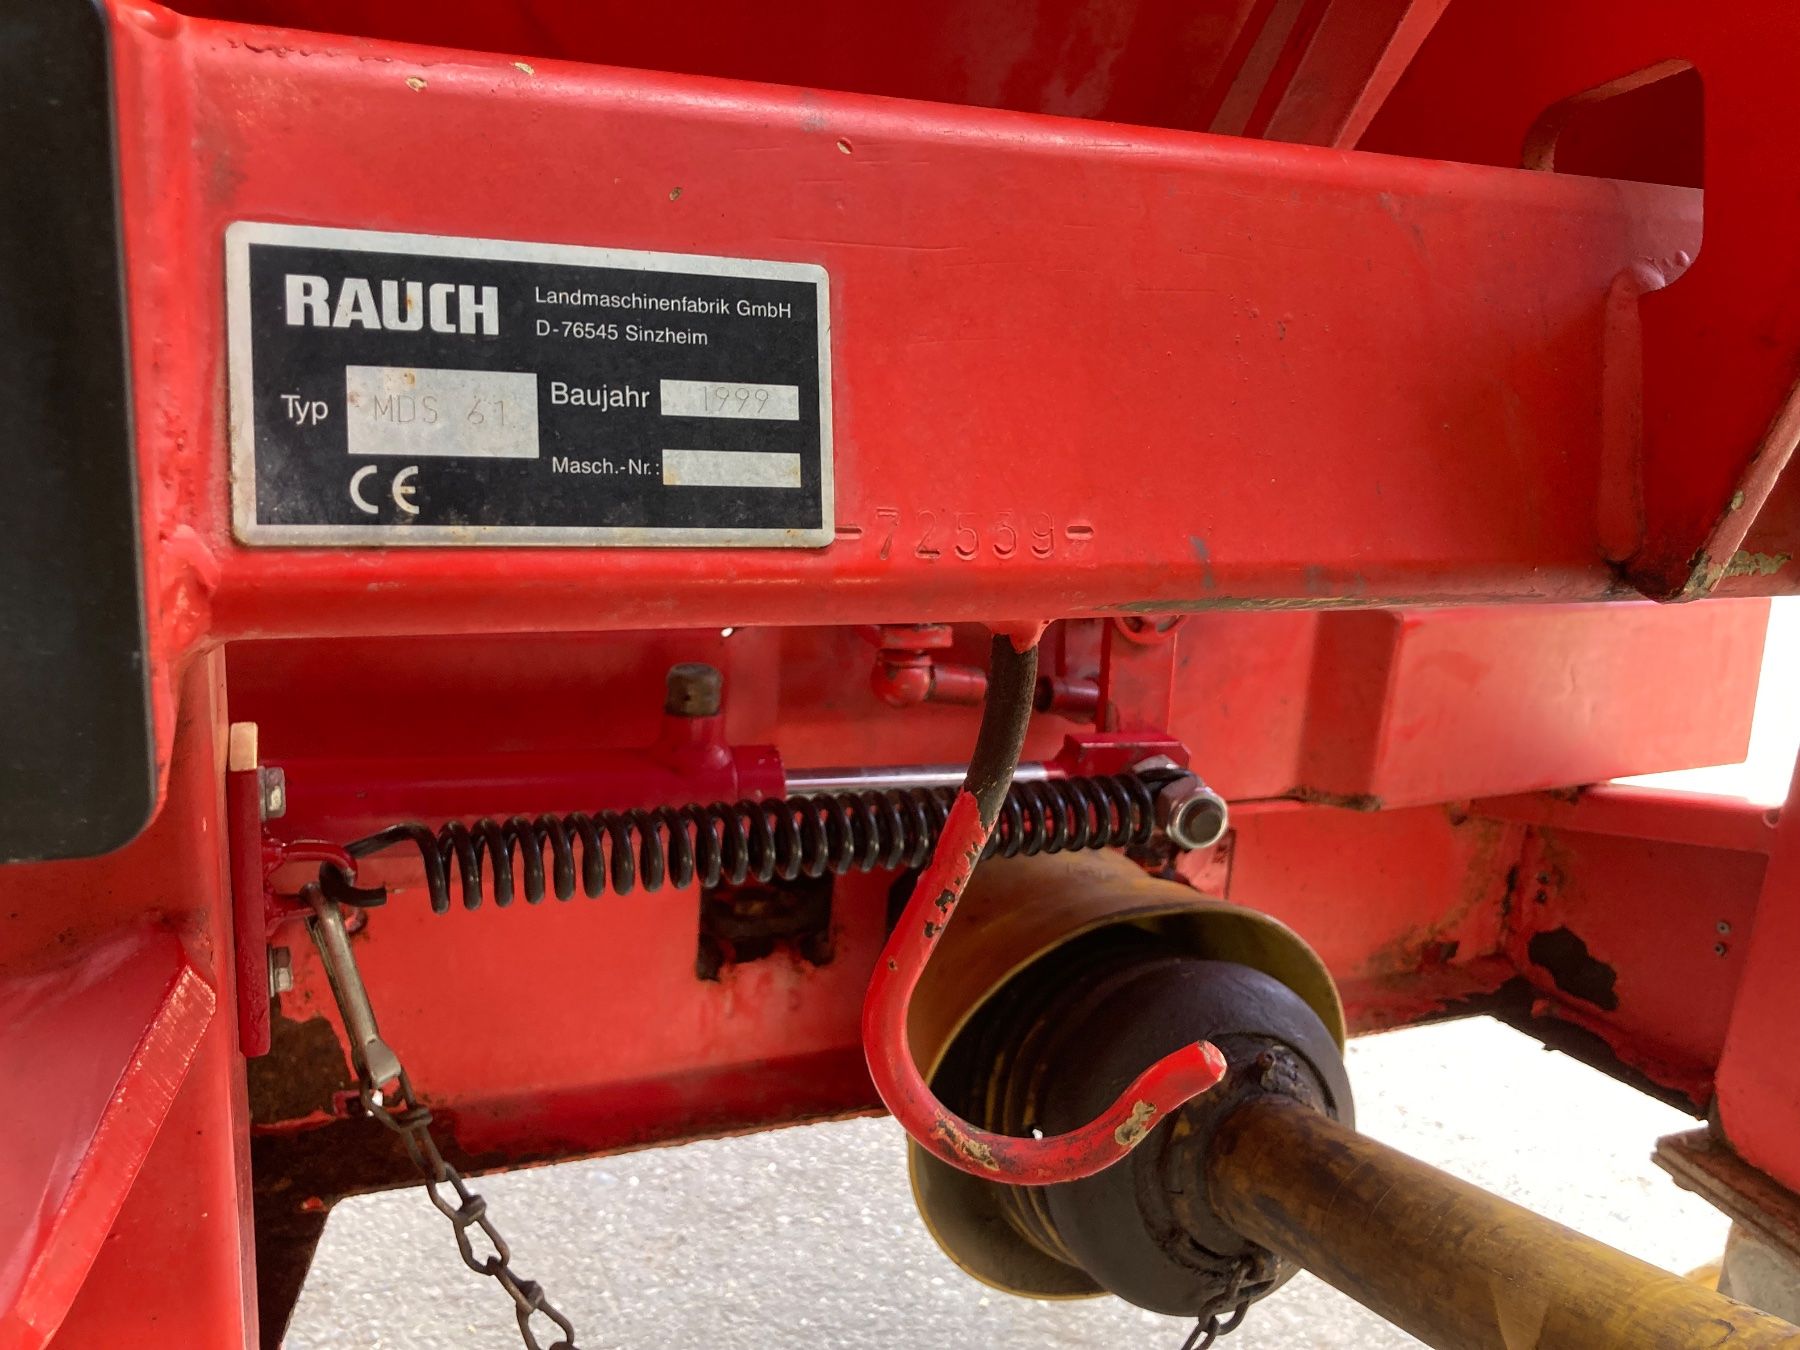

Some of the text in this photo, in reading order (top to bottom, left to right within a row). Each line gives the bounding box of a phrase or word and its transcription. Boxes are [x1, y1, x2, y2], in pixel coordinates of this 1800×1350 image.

[285, 273, 500, 336] RAUCH
[534, 285, 793, 320] Landmaschinenfabrik GmbH
[535, 320, 709, 346] D-76545 Sinzheim
[280, 393, 505, 426] Typ MDS 61
[550, 381, 769, 413] Baujahr 1999
